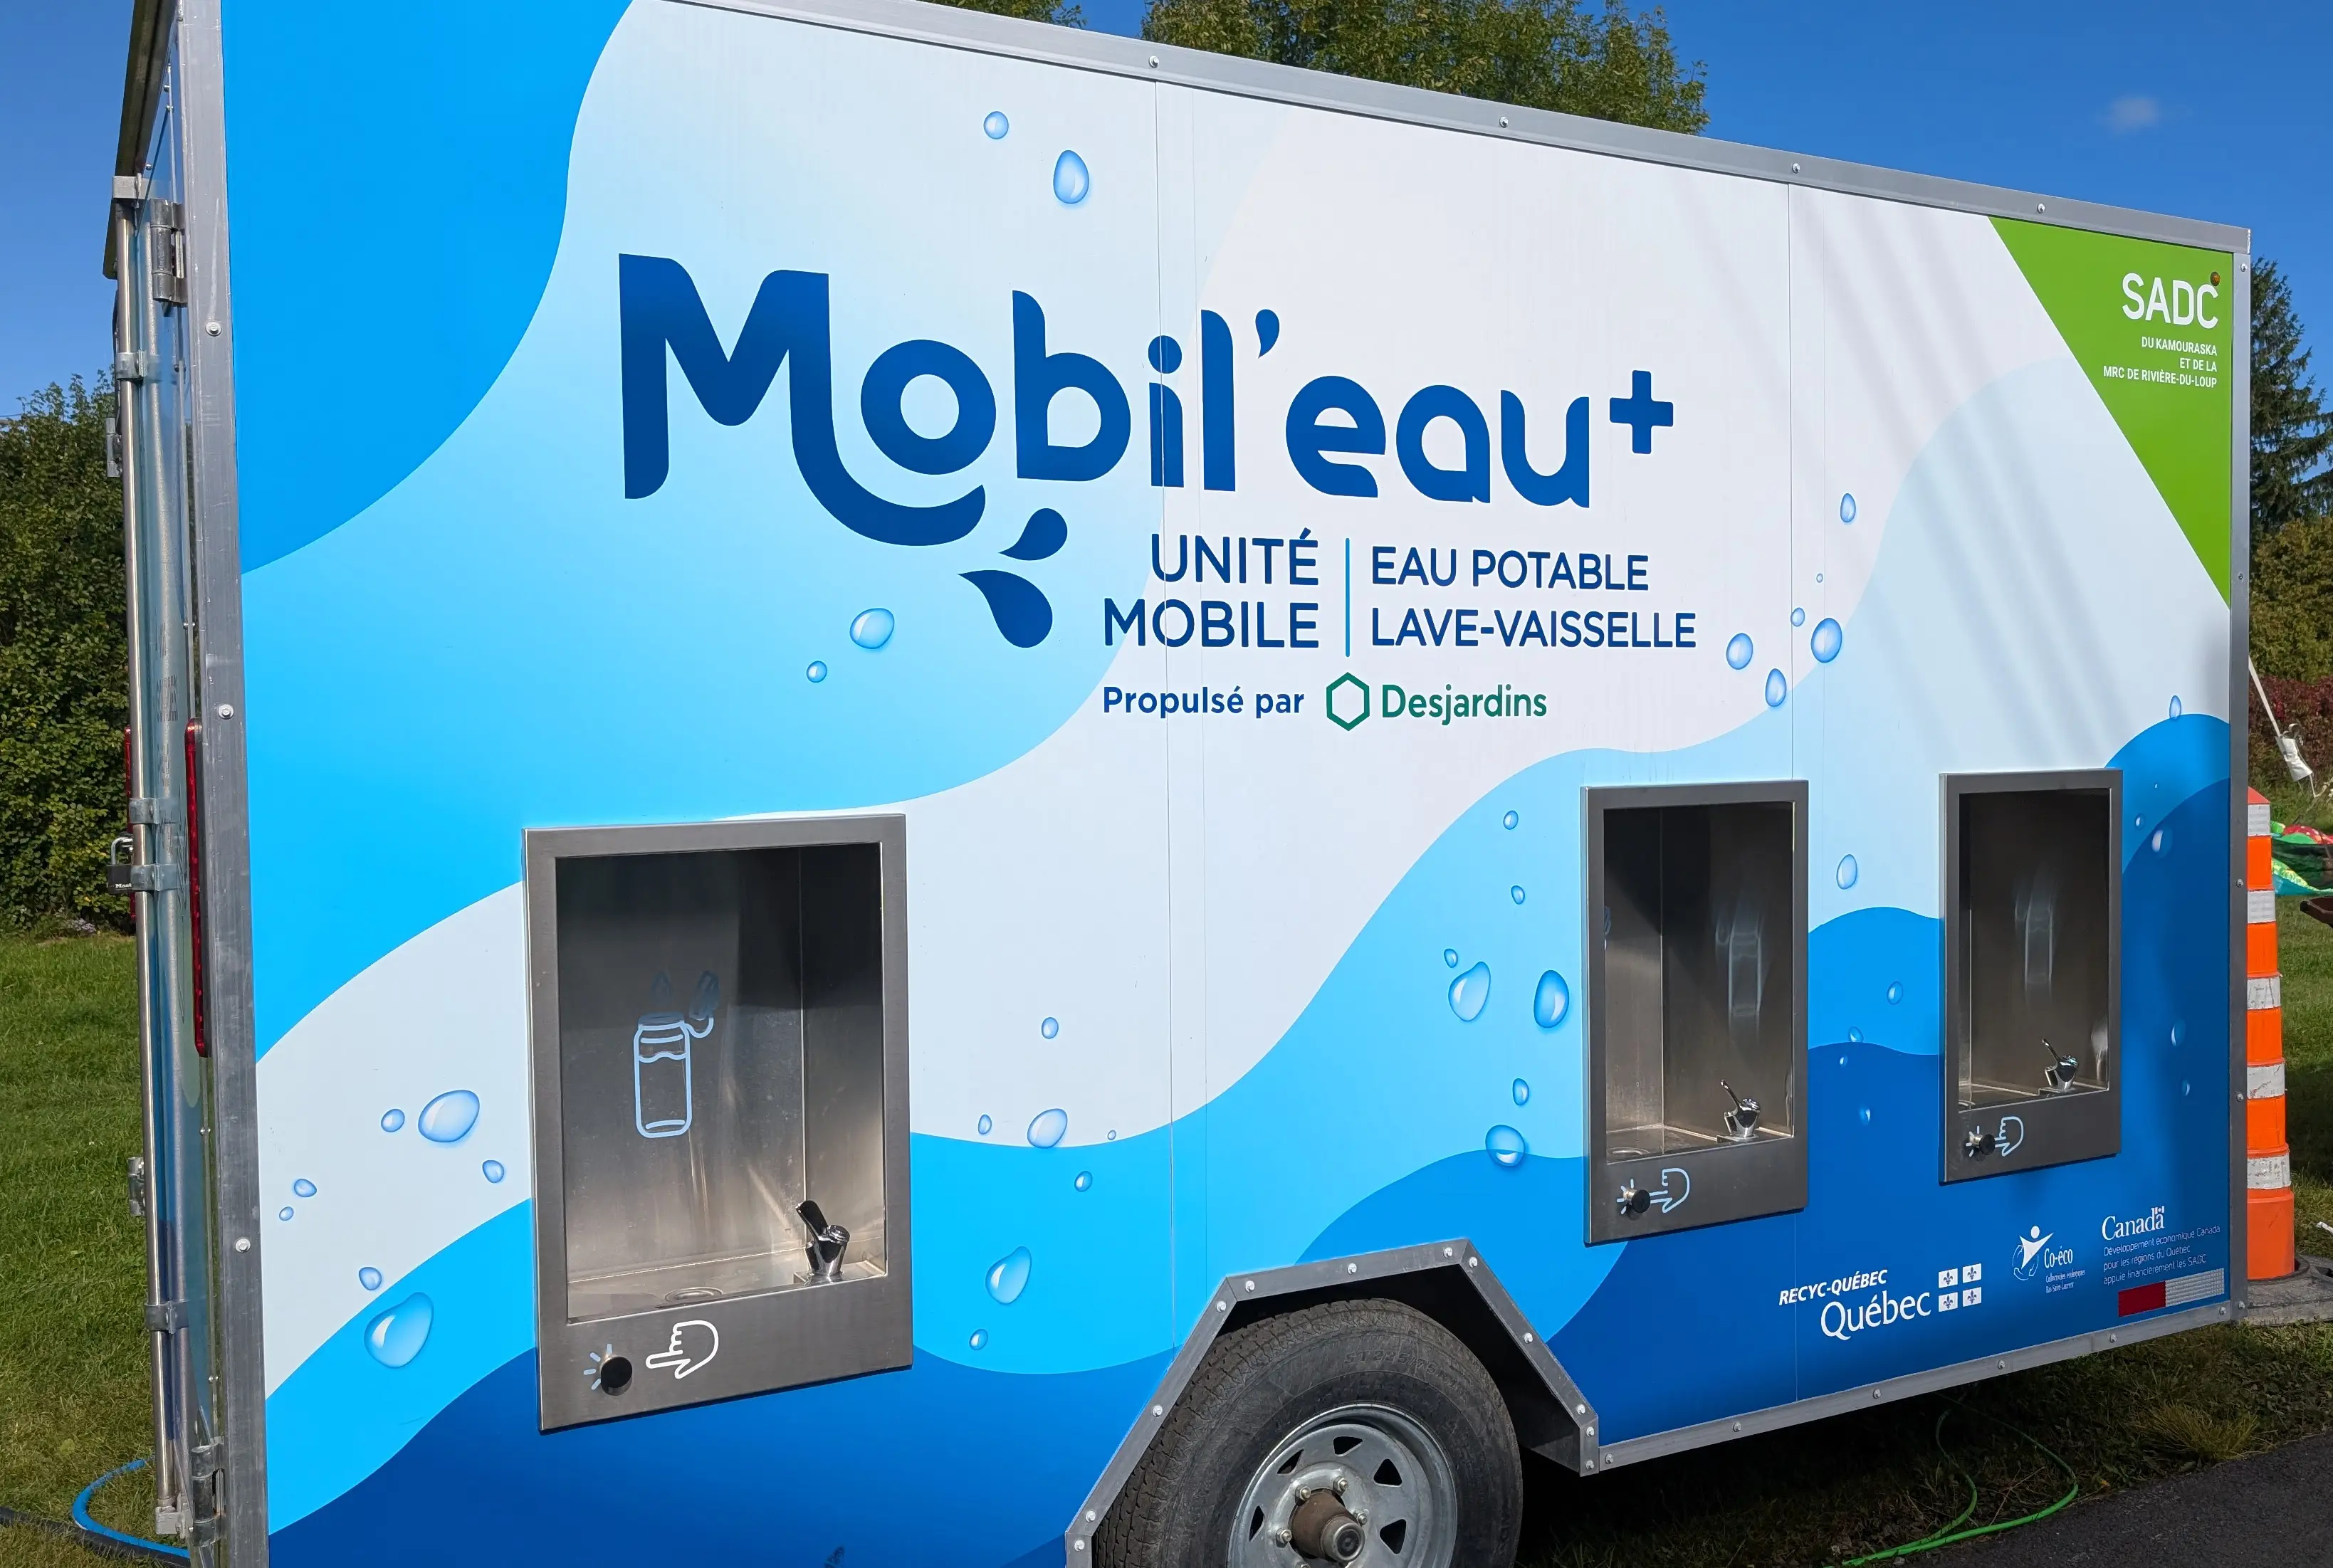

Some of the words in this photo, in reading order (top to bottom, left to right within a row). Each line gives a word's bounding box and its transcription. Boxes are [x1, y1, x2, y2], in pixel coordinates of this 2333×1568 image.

[2122, 273, 2218, 329] SADC
[2141, 336, 2154, 348] DU
[2156, 338, 2218, 357] KAMOURASKA
[2179, 357, 2191, 369] ET
[2193, 359, 2204, 371] DE
[2206, 360, 2218, 372] LA
[2103, 365, 2125, 379] MRC
[2127, 367, 2139, 380] DE
[2141, 369, 2217, 389] RIVIÈRE-DU-LOUP
[1151, 527, 1319, 586] UNITÉ
[1372, 545, 1457, 586] EAU
[1472, 549, 1649, 591] POTABLE
[1103, 597, 1320, 648] MOBILE
[1372, 607, 1697, 648] LAVE-VAISSELLE
[1103, 685, 1244, 719] Propulsé
[1256, 693, 1304, 719] par
[1382, 683, 1547, 726] Desjardins
[2102, 1206, 2165, 1241] Canada
[2104, 1238, 2154, 1256] Développement
[2156, 1230, 2195, 1245] économique
[2196, 1225, 2221, 1237] Canada
[2044, 1246, 2073, 1268] Co-éco
[2104, 1261, 2119, 1272] pour
[2120, 1258, 2130, 1267] les
[2131, 1252, 2155, 1266] régions
[2156, 1250, 2164, 1258] du
[2166, 1246, 2191, 1257] Québec
[2104, 1272, 2126, 1285] appuie
[2127, 1262, 2176, 1278] financièrement
[2176, 1259, 2186, 1268] les
[2187, 1254, 2207, 1266] SADC
[1778, 1269, 1888, 1306] RECYC-QUÉBEC
[1820, 1290, 1931, 1341] Québec
